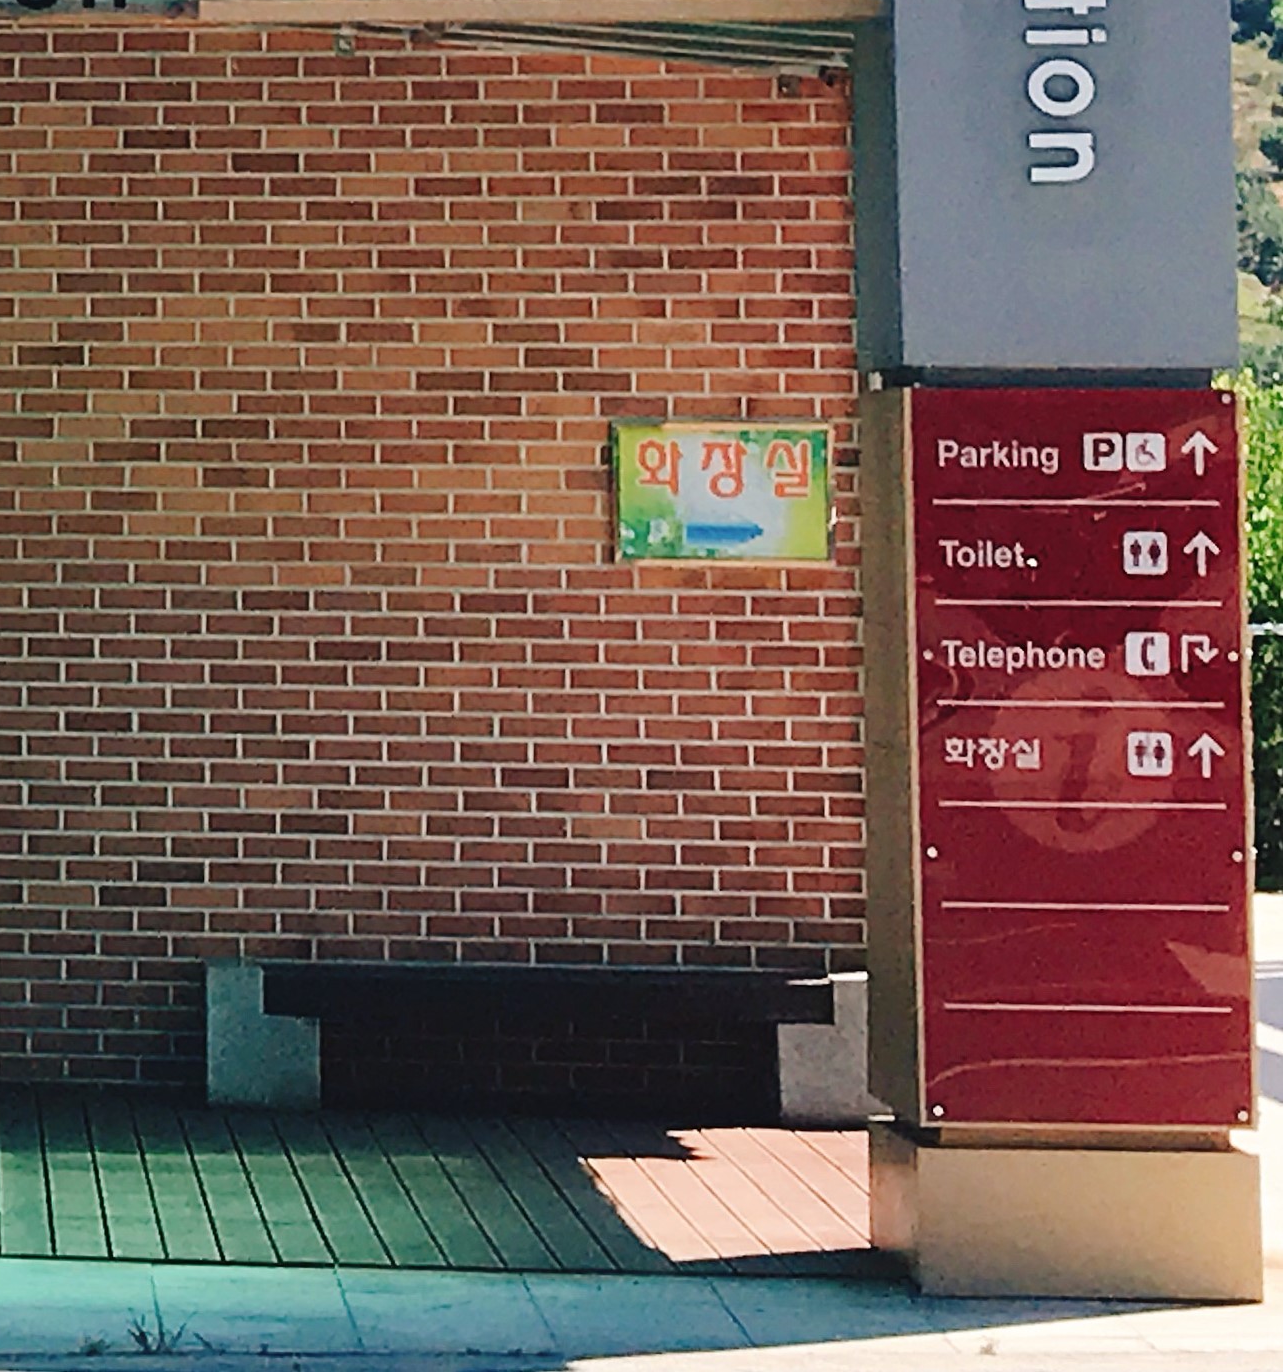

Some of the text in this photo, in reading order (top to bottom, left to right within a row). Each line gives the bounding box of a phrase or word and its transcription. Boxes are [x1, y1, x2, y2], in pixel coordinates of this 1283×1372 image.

[637, 440, 811, 499] 화장실
[937, 439, 1059, 475] Parking
[941, 639, 1106, 676] Telephone
[943, 737, 1041, 771] 화장실
